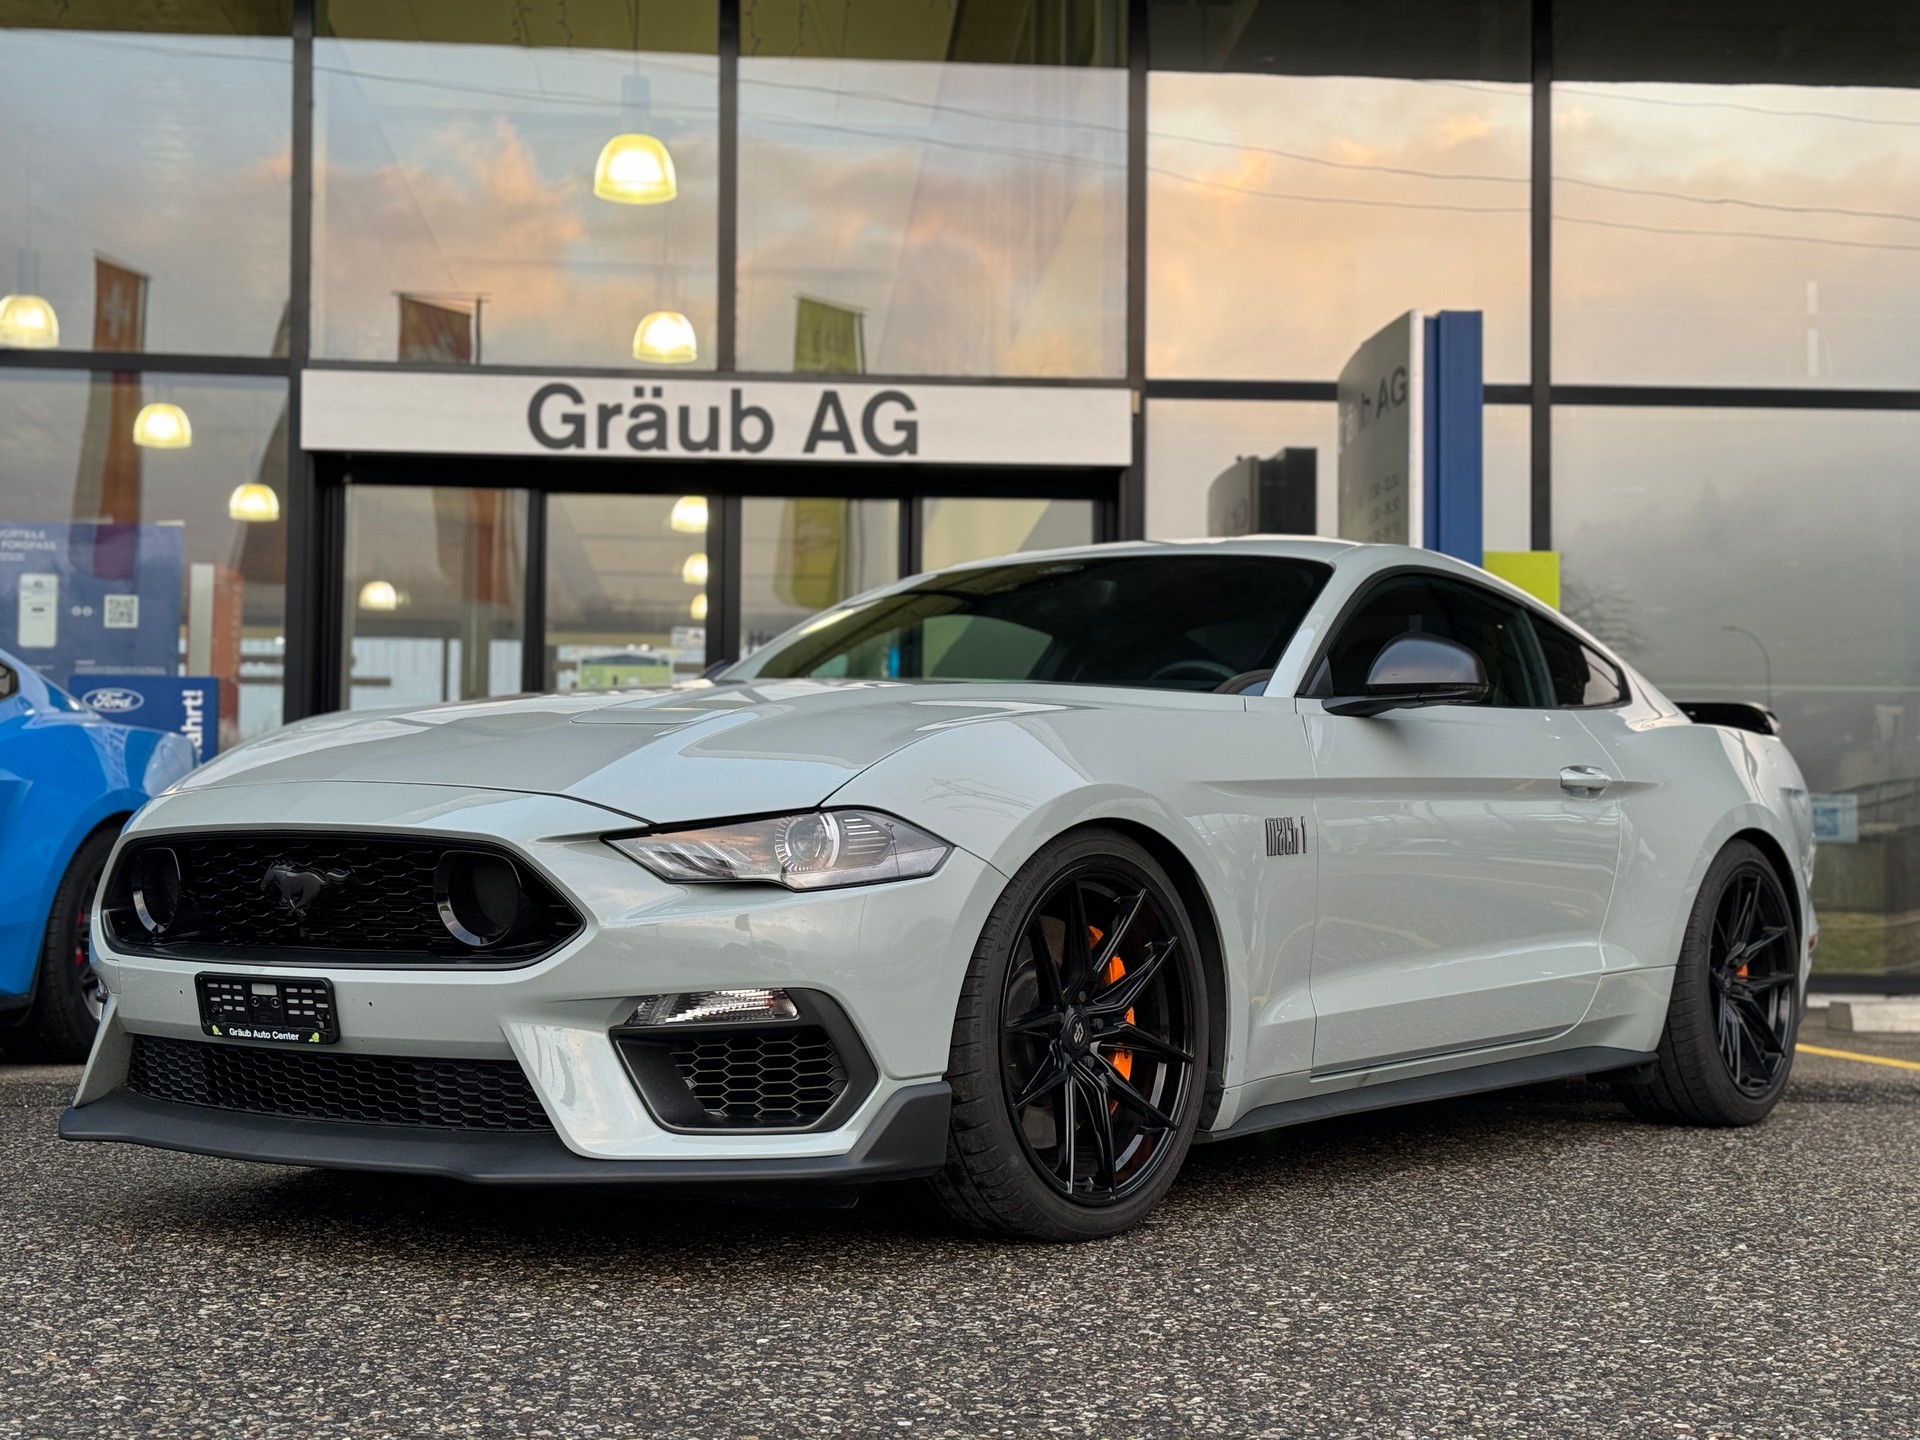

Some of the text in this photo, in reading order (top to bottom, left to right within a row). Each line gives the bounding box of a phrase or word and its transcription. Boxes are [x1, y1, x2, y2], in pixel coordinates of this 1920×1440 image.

[527, 382, 919, 457] Gräub AG
[92, 690, 134, 709] Ford
[181, 689, 204, 755] ahrt!
[228, 1027, 300, 1041] Gräub Auto Center
